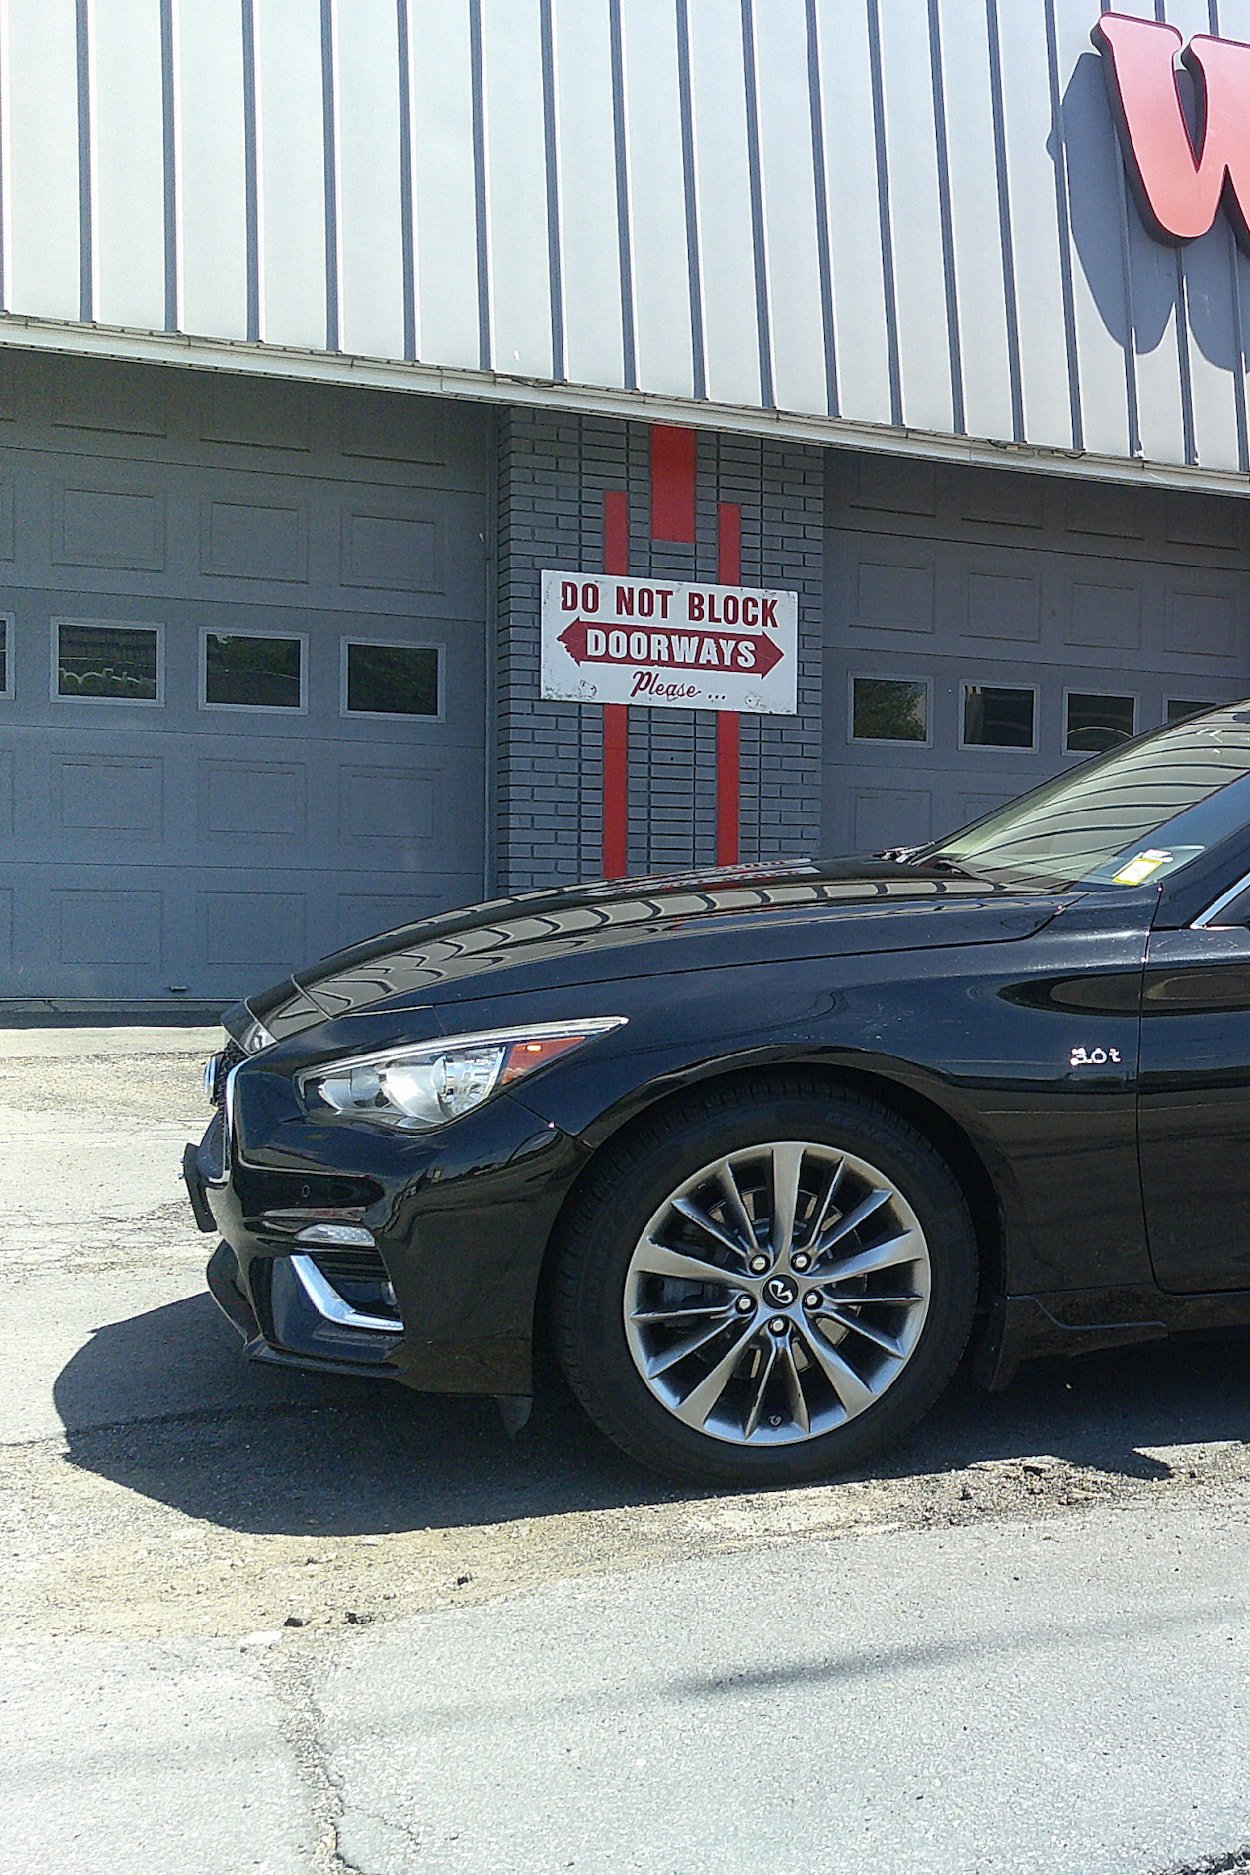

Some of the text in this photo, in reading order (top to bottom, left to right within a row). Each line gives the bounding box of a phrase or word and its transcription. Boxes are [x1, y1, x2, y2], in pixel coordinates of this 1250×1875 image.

[560, 580, 779, 629] DO NOT BLOCK
[585, 627, 757, 668] DOORWAYS
[629, 670, 702, 698] Please
